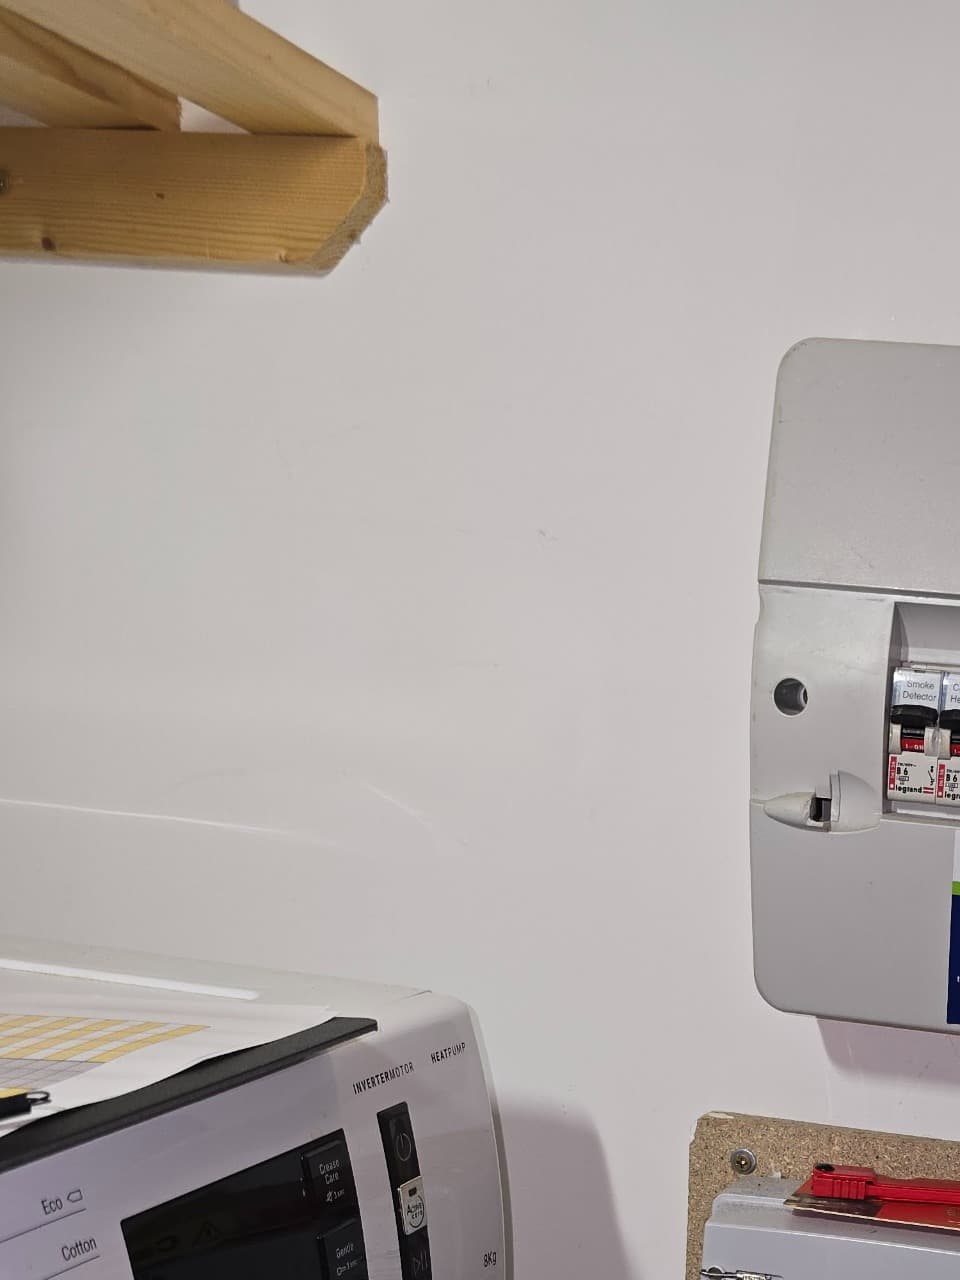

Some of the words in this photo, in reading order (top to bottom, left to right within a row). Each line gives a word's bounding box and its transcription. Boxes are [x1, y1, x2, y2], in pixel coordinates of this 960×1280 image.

[906, 680, 935, 690] Smoke
[902, 691, 937, 702] Detector
[896, 785, 922, 793] legrand
[430, 1042, 466, 1064] HEATPUMP
[352, 1061, 415, 1095] INVERTERMOTOR
[319, 1159, 340, 1175] Crease
[324, 1172, 339, 1185] Care
[41, 1198, 64, 1215] Eco
[61, 1237, 97, 1261] Cotton
[483, 1251, 497, 1268] 8Kg
